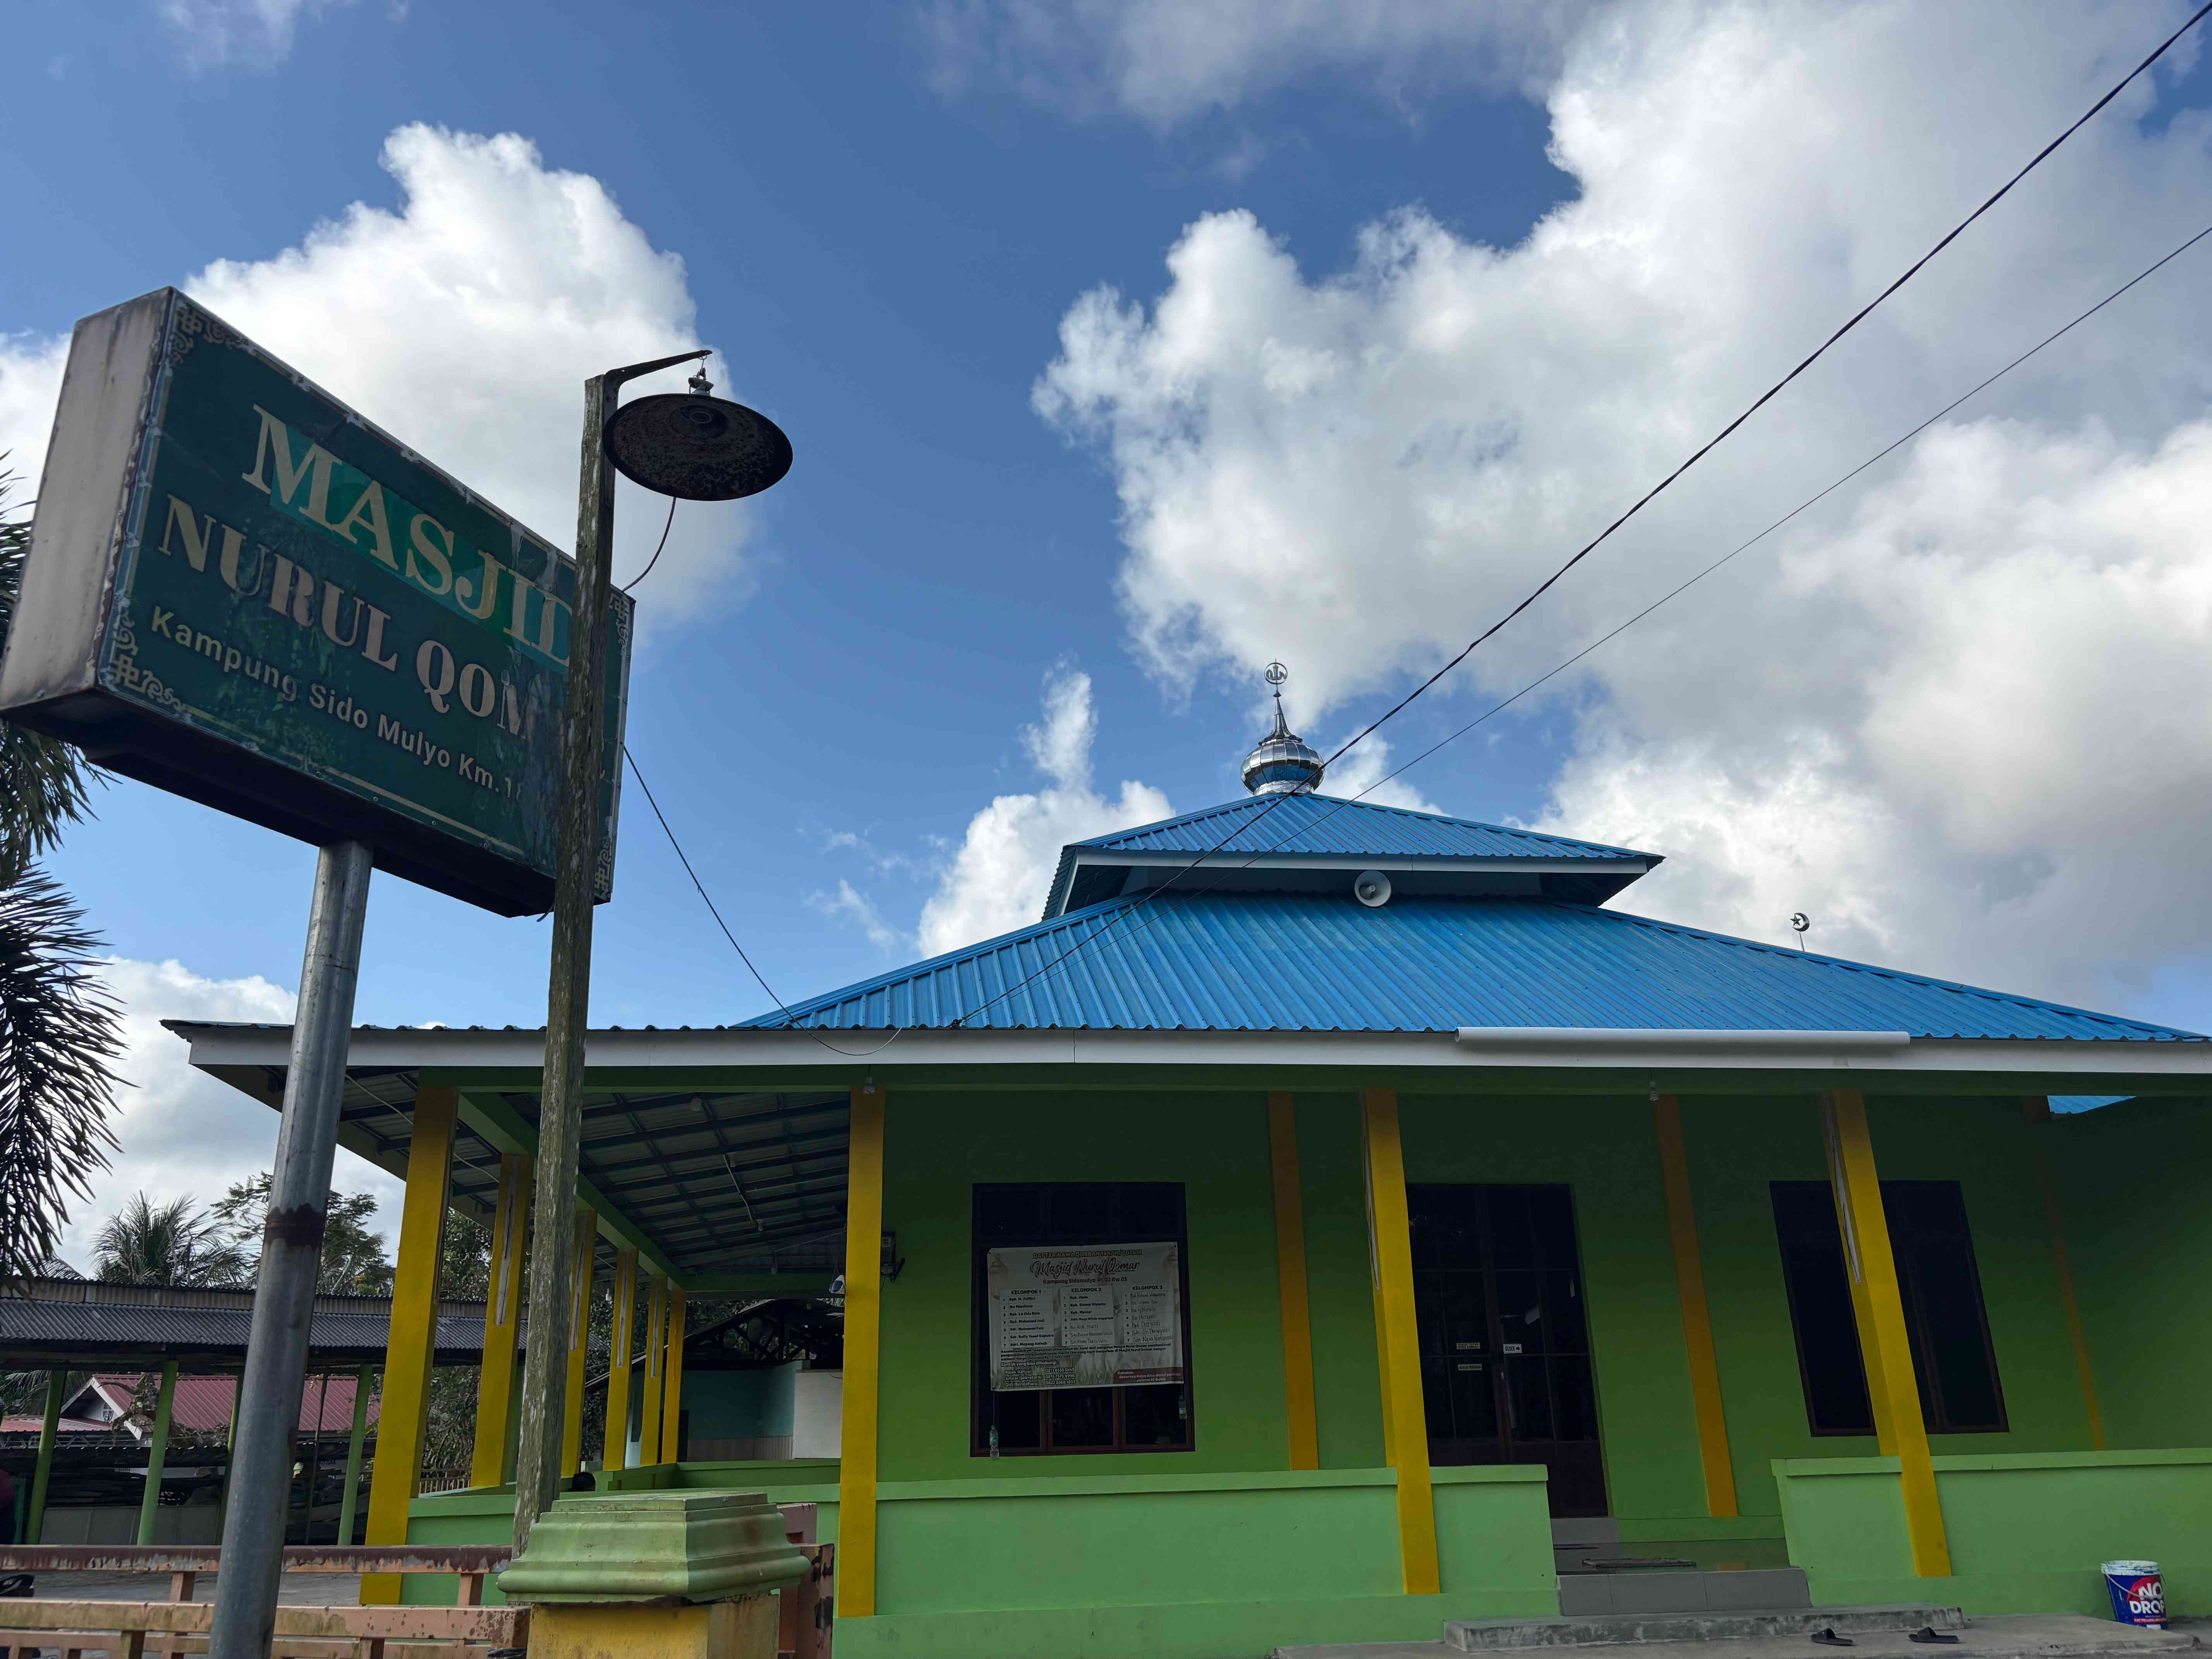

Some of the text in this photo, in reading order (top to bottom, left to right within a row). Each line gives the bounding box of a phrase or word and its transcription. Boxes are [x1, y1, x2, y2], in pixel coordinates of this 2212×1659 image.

[157, 494, 398, 671] NURUL
[151, 605, 299, 702] Kampung
[309, 683, 368, 728] Sido
[378, 714, 450, 767] Mulyo
[1030, 1257, 1140, 1279] Masjid Nurul Qomar
[2138, 1582, 2162, 1600] NO
[2129, 1600, 2165, 1614] DROP
